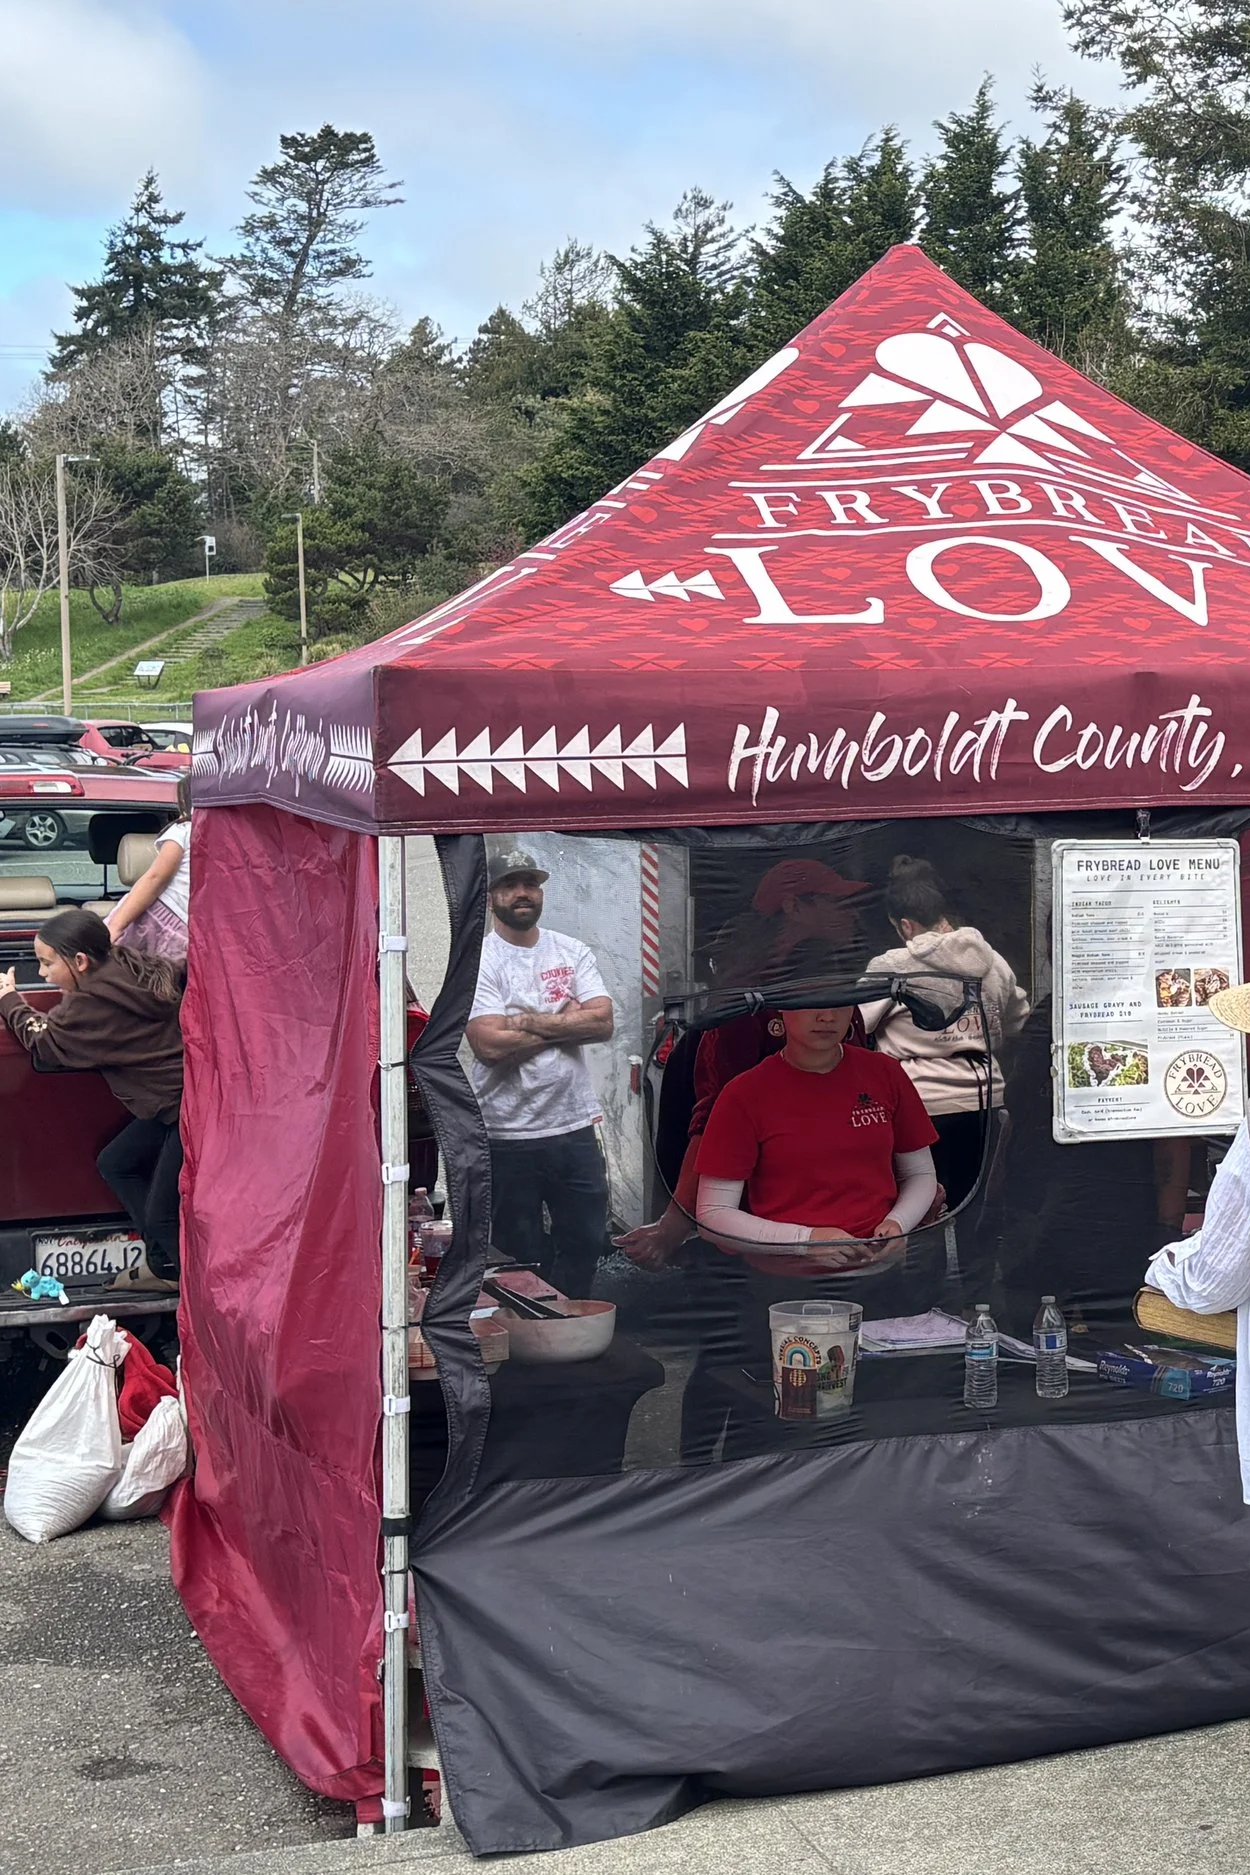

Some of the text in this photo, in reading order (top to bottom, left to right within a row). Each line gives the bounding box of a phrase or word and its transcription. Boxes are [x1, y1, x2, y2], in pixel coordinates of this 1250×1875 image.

[727, 698, 1029, 806] Humboldt
[1032, 694, 1243, 792] County,
[1077, 858, 1221, 872] FRYBREAD LOVE MENU
[1086, 874, 1111, 882] LOVE
[1139, 873, 1171, 881] EVERY
[1129, 1000, 1142, 1008] AND
[1168, 1053, 1223, 1080] FRYBREAD
[1175, 1094, 1218, 1115] LOVE
[851, 1111, 888, 1128] LOVE
[1167, 1382, 1184, 1393] 720
